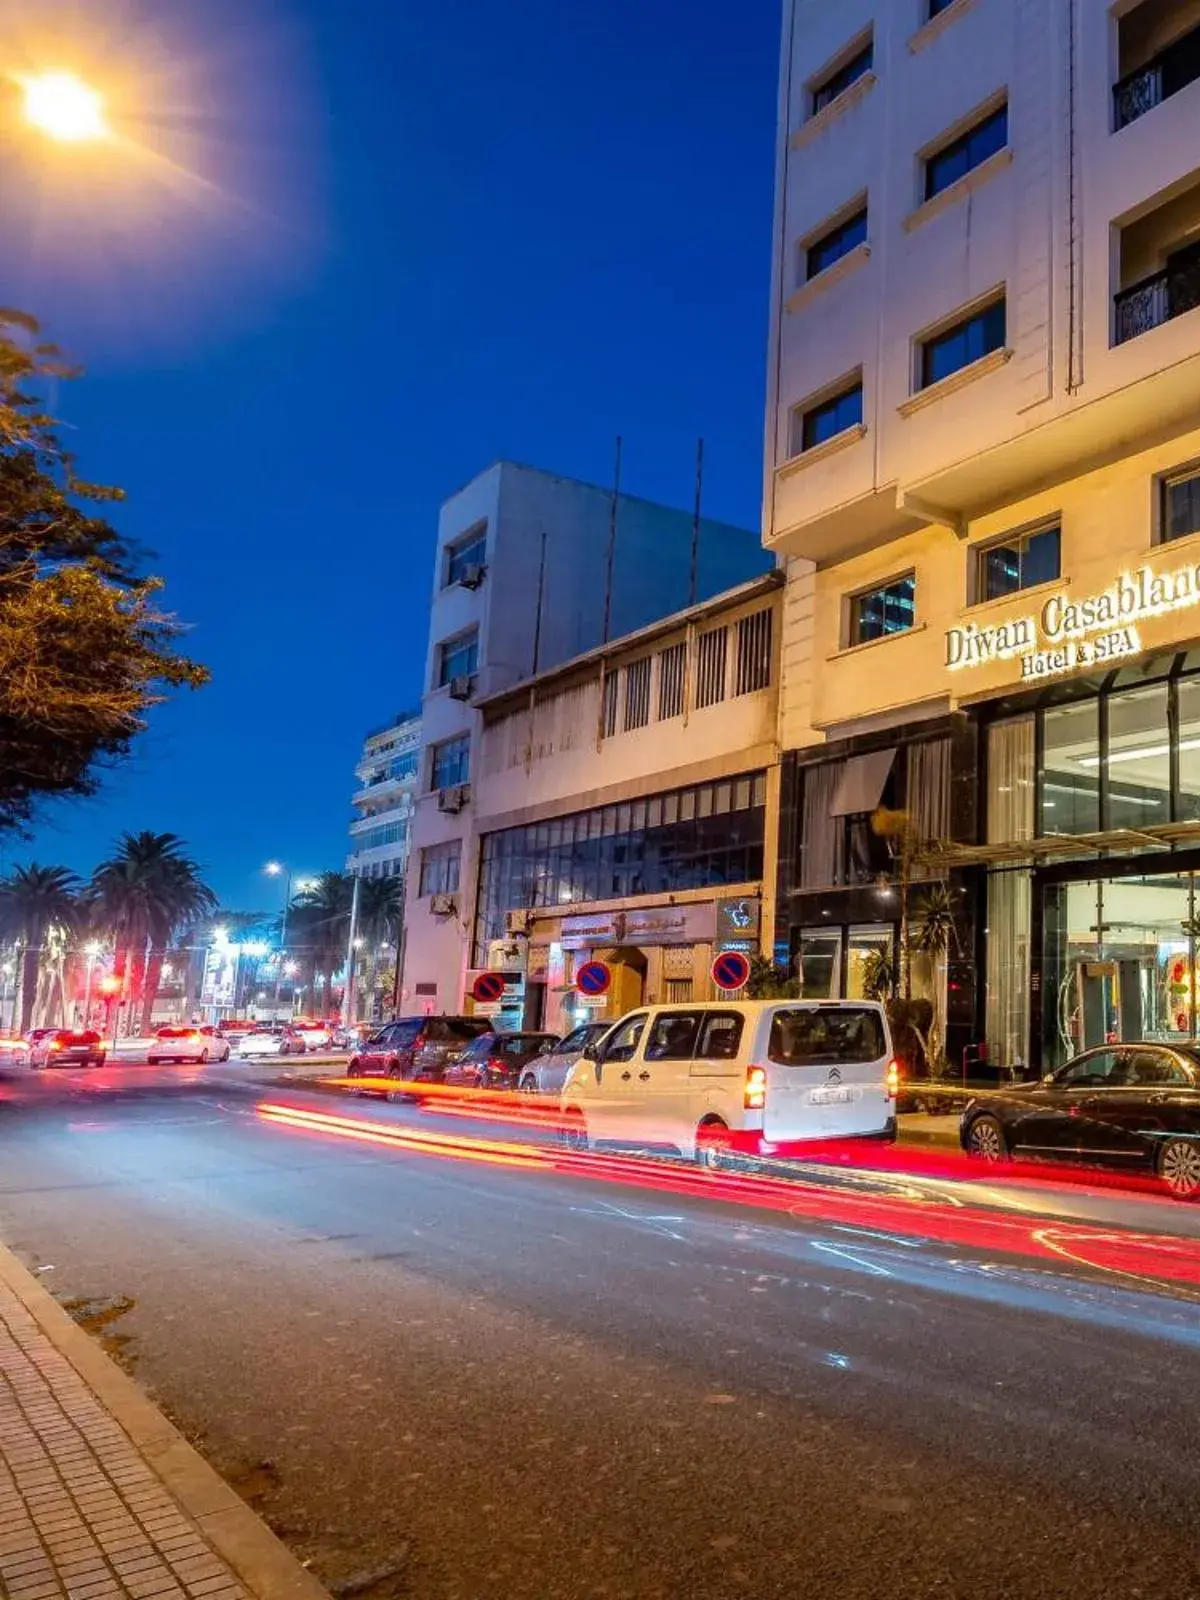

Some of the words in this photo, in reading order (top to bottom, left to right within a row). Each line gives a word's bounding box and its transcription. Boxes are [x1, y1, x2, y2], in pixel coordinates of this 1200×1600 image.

[944, 618, 1031, 667] Diwan
[1076, 646, 1088, 663] &
[1093, 630, 1135, 659] SPA
